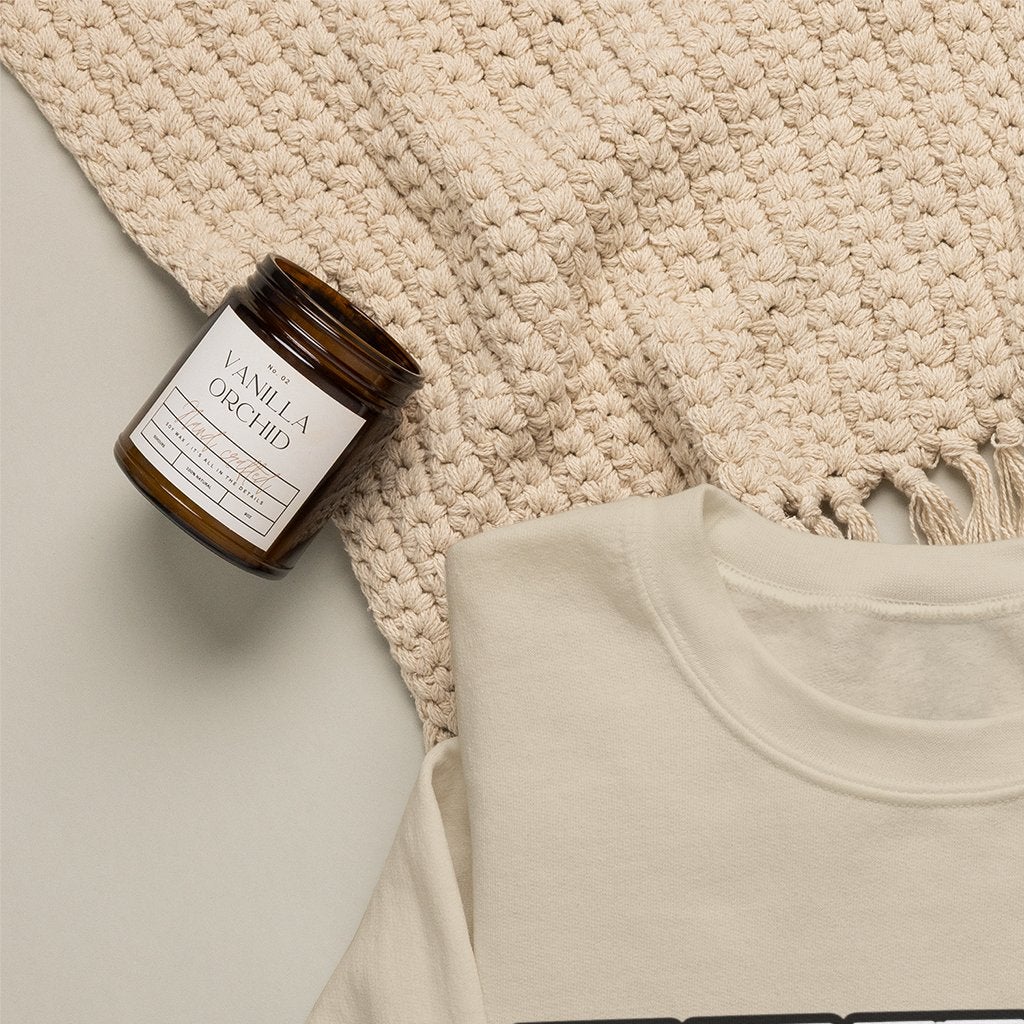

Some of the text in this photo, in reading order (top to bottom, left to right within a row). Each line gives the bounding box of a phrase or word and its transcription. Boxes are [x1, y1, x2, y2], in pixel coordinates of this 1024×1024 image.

[224, 349, 310, 434] VANILLA
[267, 364, 291, 385] No. 02
[208, 377, 291, 450] ORCHID
[175, 432, 185, 443] WAX
[203, 457, 214, 469] ALL
[225, 475, 237, 486] THE
[238, 485, 264, 506] DETAILS
